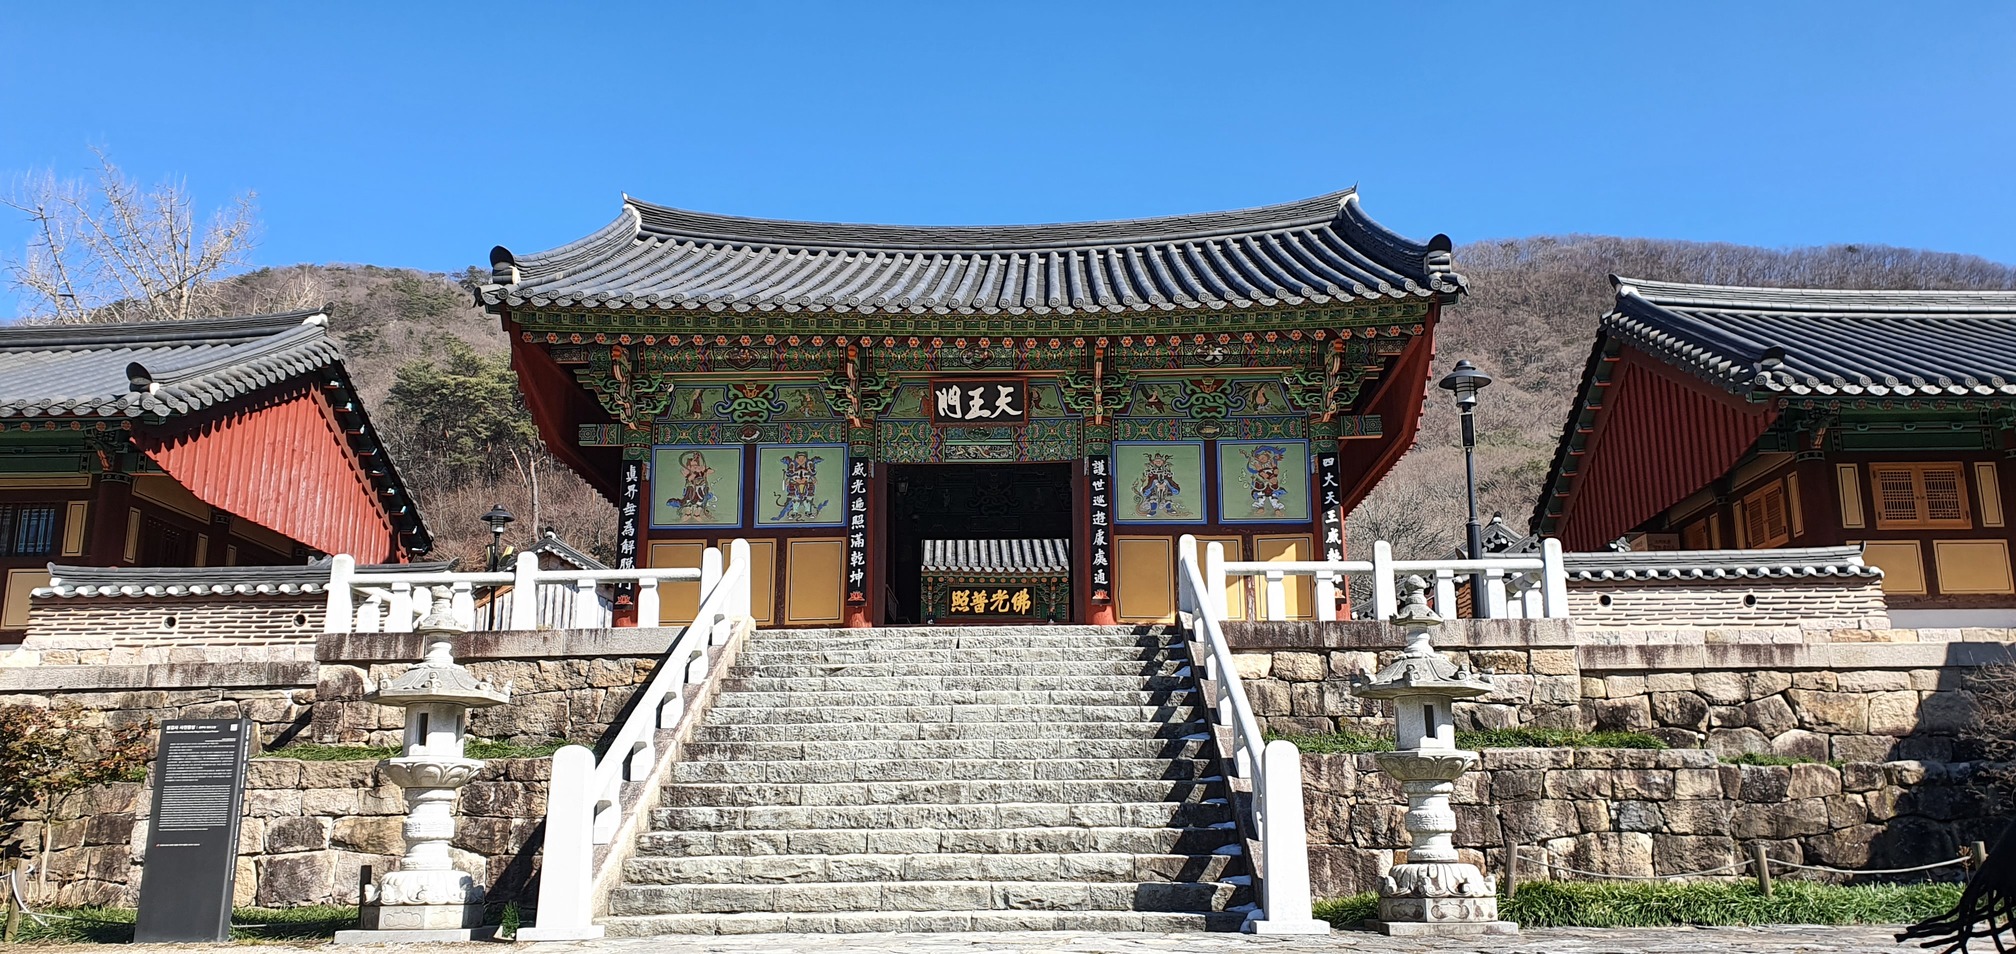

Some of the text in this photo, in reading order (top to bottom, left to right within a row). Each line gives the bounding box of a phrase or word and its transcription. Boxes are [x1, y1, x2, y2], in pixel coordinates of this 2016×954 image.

[935, 385, 1023, 420] 天王門
[950, 588, 1031, 615] 佛光普照
